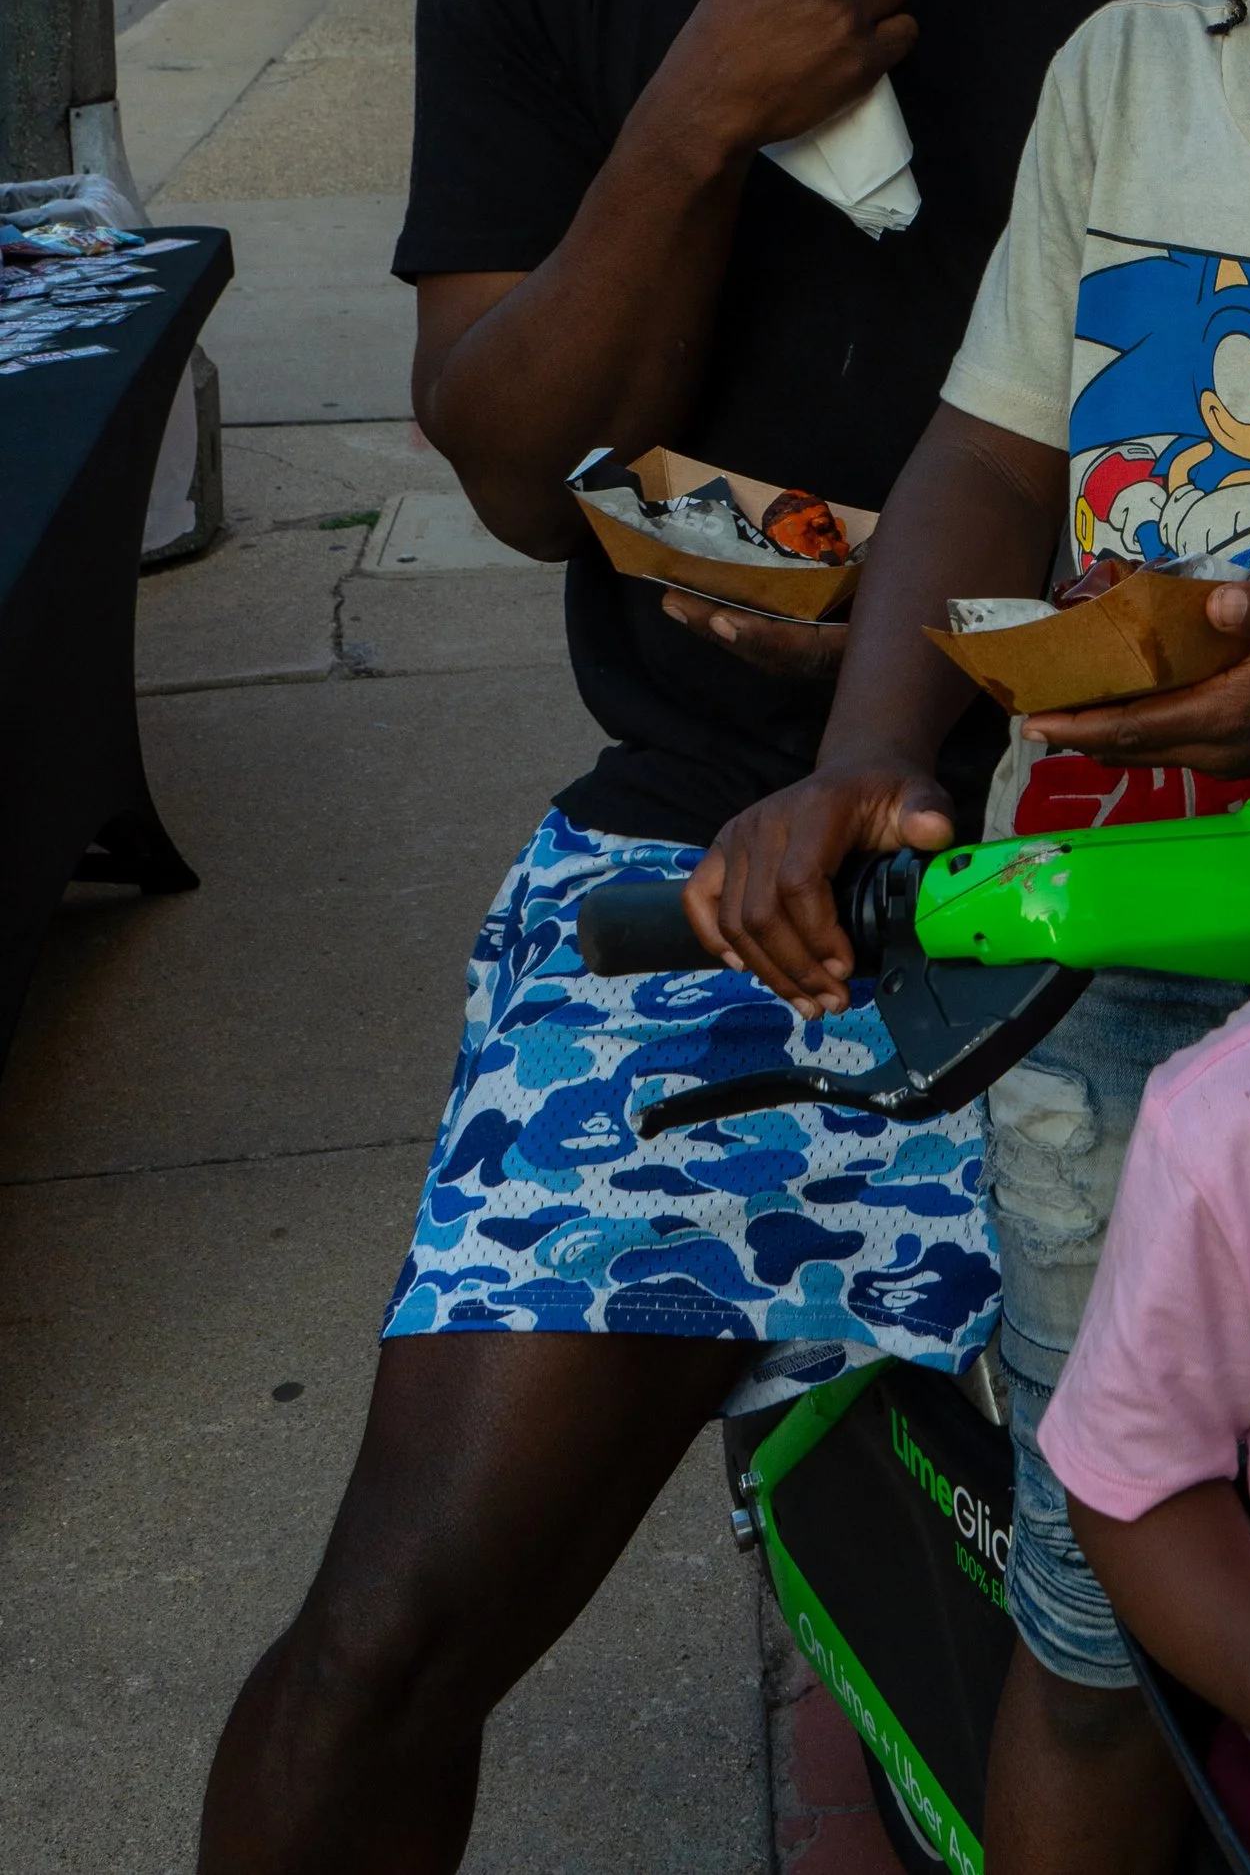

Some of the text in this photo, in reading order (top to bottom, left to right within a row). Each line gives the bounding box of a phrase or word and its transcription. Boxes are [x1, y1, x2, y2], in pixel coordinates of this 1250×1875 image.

[954, 1540, 989, 1594] 100%
[798, 1611, 828, 1676] On
[830, 1649, 877, 1743] Lime
[894, 1741, 943, 1841] Uber
